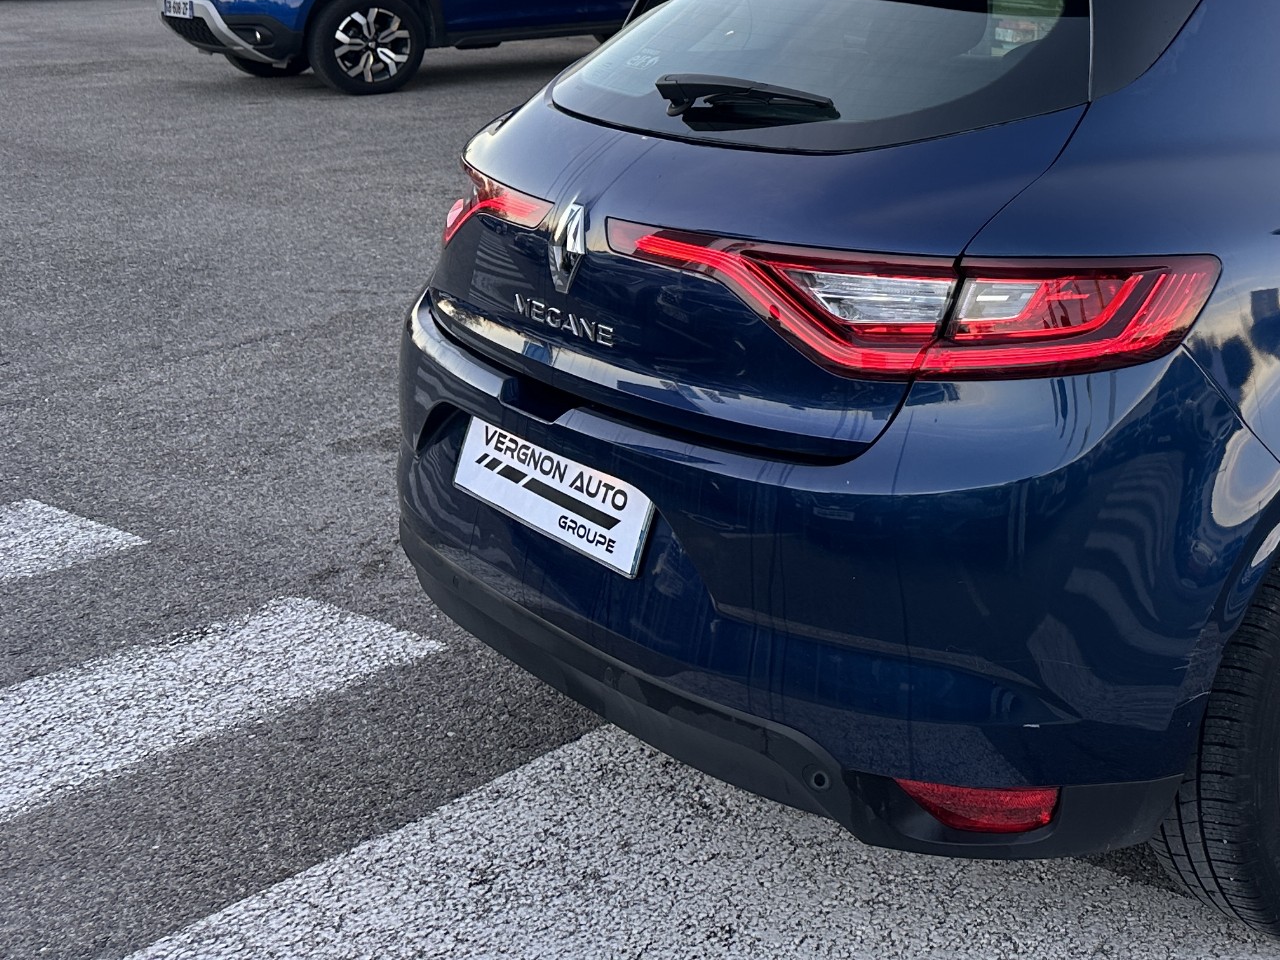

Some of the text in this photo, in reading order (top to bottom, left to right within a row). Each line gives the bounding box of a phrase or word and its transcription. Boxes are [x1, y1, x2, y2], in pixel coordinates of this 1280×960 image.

[514, 293, 613, 347] MEGANE
[484, 426, 628, 511] VERGNON AUTO
[558, 515, 616, 554] GROUPE
